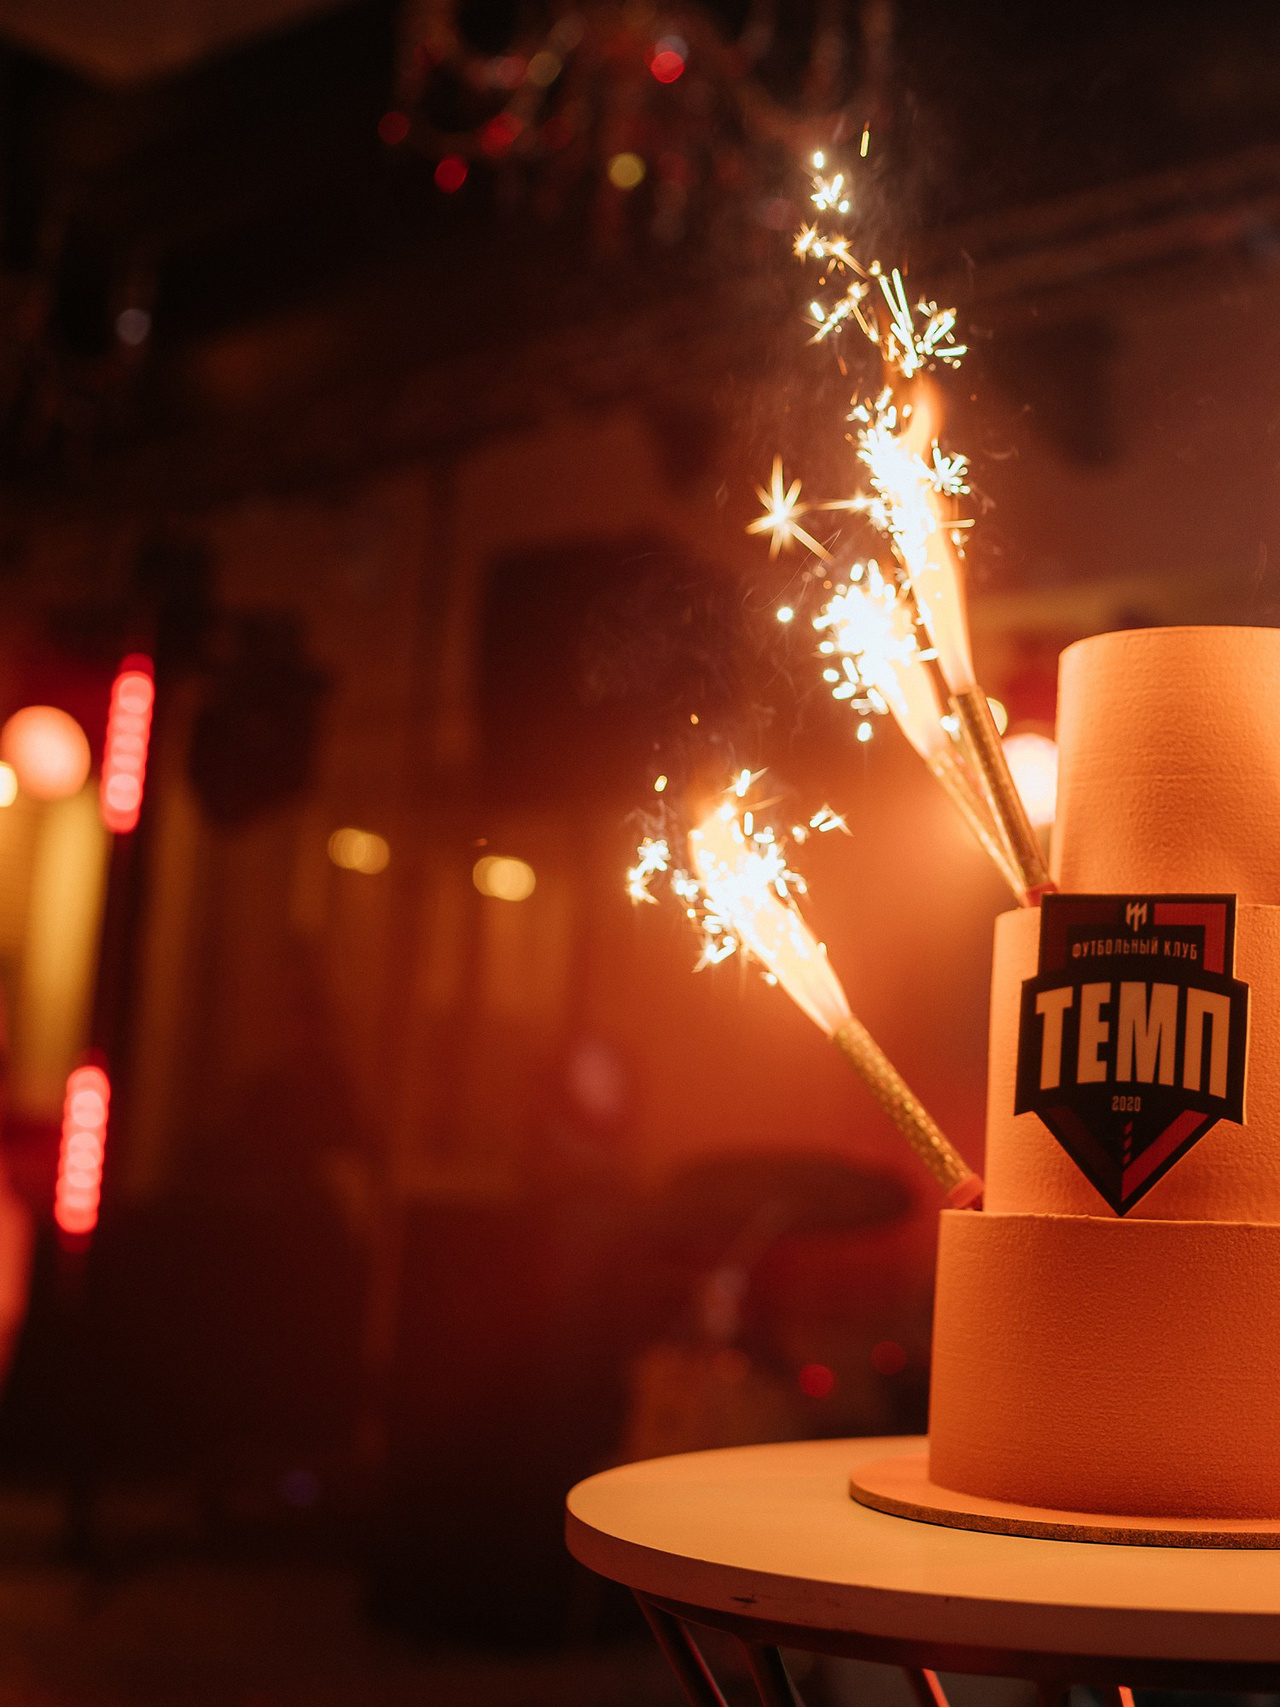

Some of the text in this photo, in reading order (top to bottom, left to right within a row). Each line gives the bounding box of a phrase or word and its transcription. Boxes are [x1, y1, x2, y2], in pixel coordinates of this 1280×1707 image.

[1072, 936, 1198, 960] ФУТБОЛЬНЫЙ КЛУБ
[1035, 981, 1231, 1099] ТЕМП
[1111, 1095, 1142, 1112] 2020
